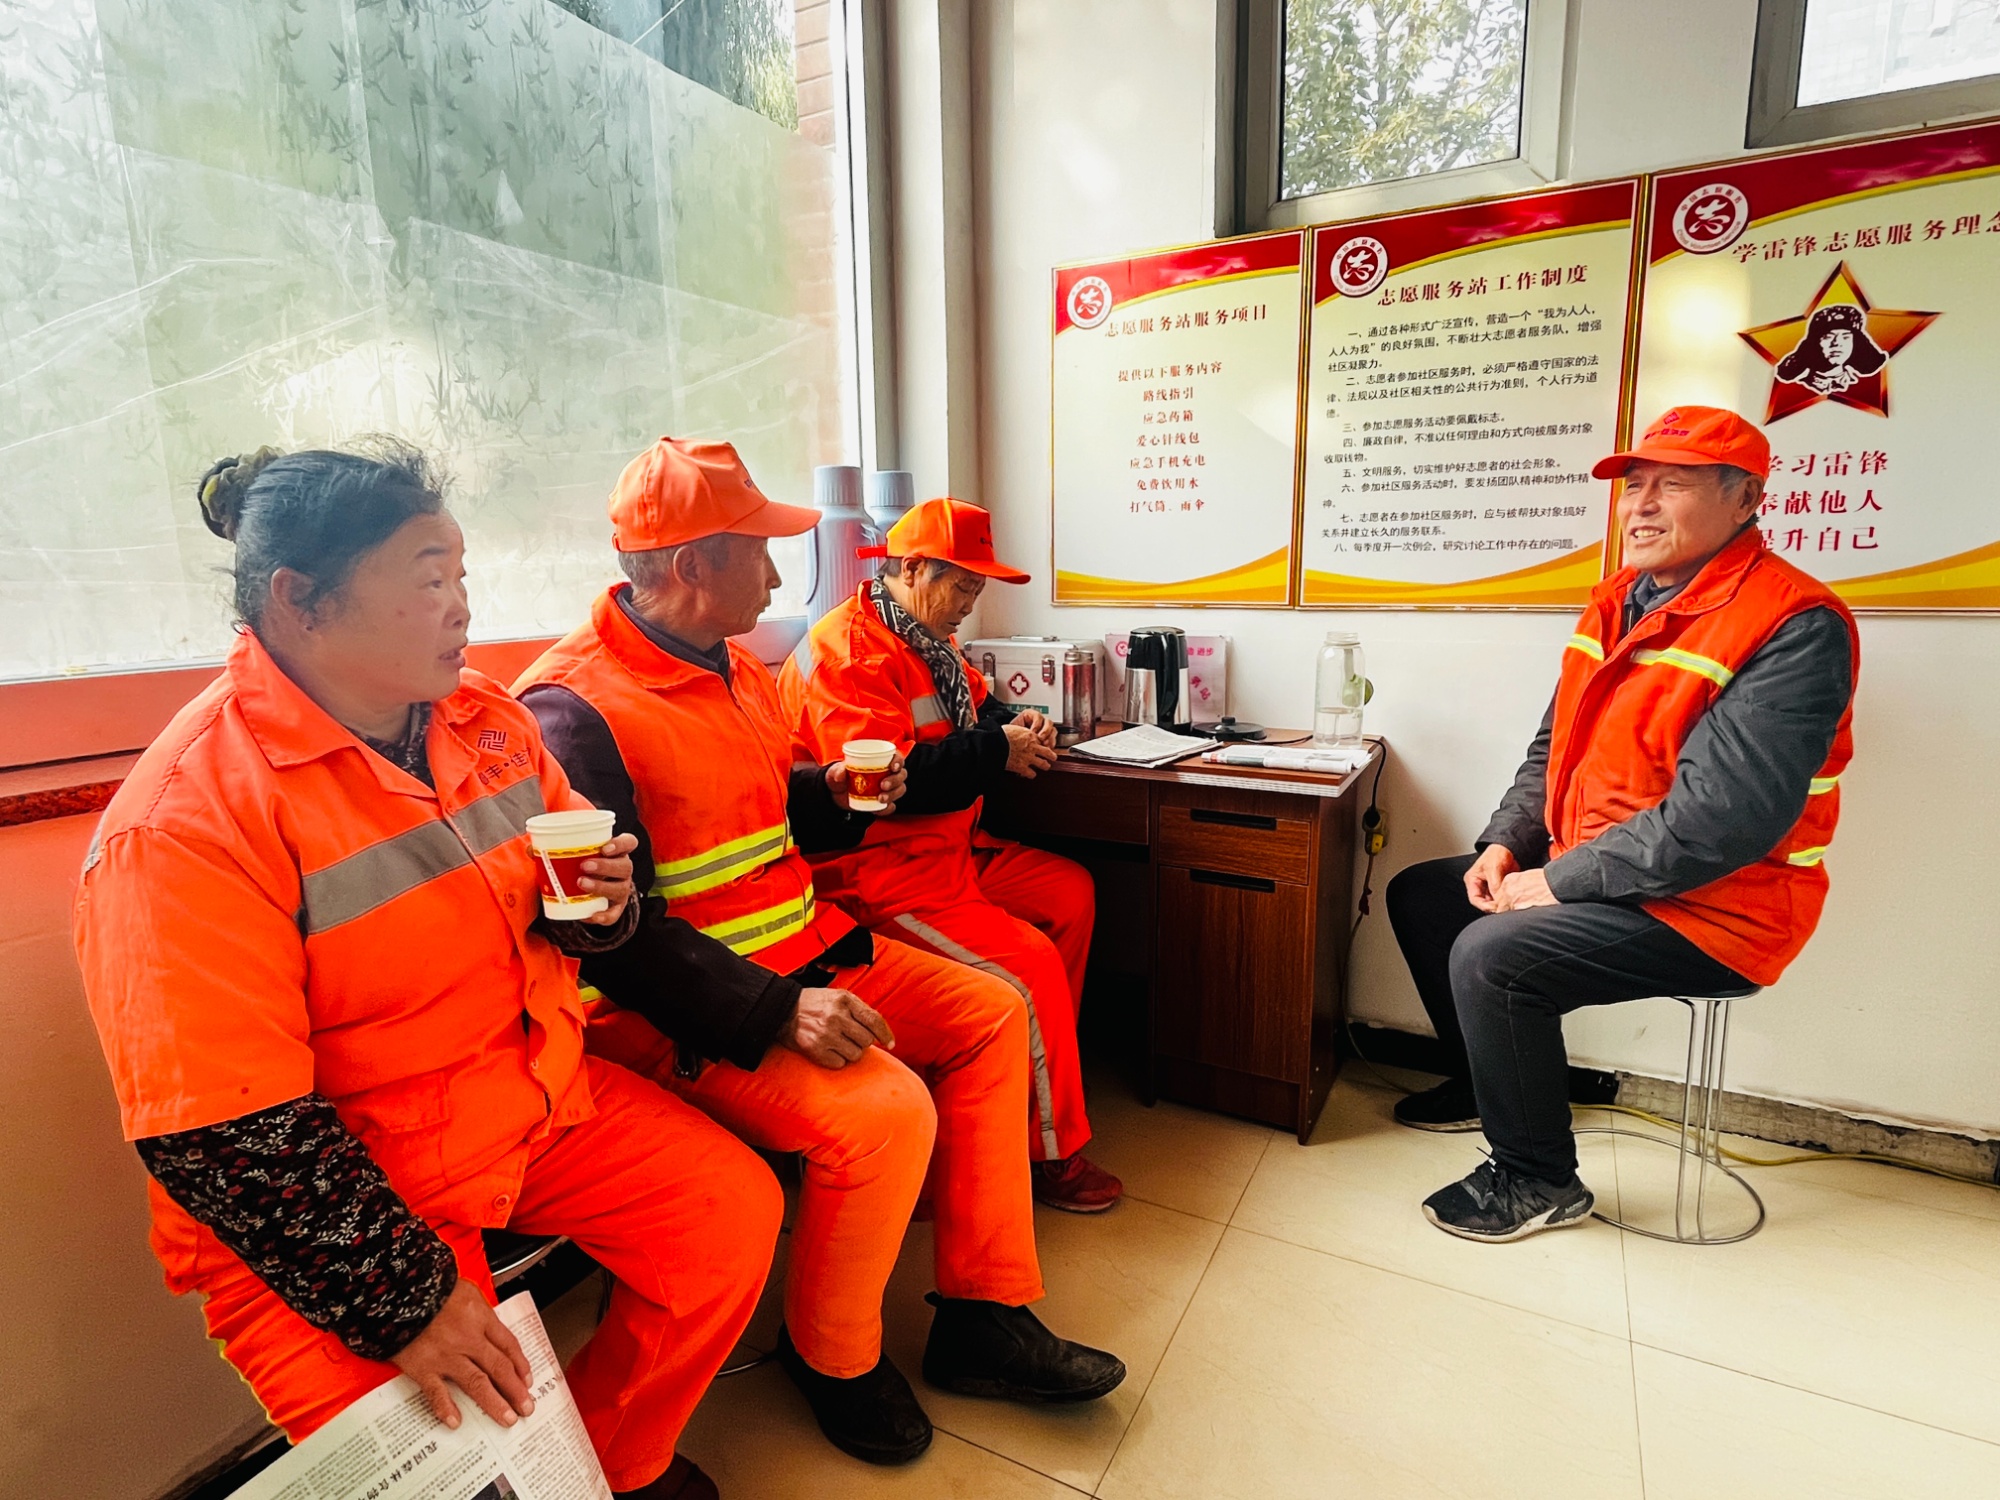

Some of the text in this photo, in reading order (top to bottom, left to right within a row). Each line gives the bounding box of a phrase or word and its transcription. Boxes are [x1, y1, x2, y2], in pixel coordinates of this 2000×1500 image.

[1377, 264, 1588, 306] 志愿服务站工作制度
[1105, 304, 1266, 337] 志愿服务站服务项目
[1118, 361, 1222, 382] 提供以下服务内容
[1143, 386, 1193, 402] 路线指引
[1143, 409, 1193, 424] 应急药箱
[1137, 431, 1200, 447] 爱心针线包
[1130, 454, 1205, 469] 应急手机充电
[1137, 477, 1199, 490] 免费饮用水
[1130, 498, 1204, 513] 打气筒、雨伞
